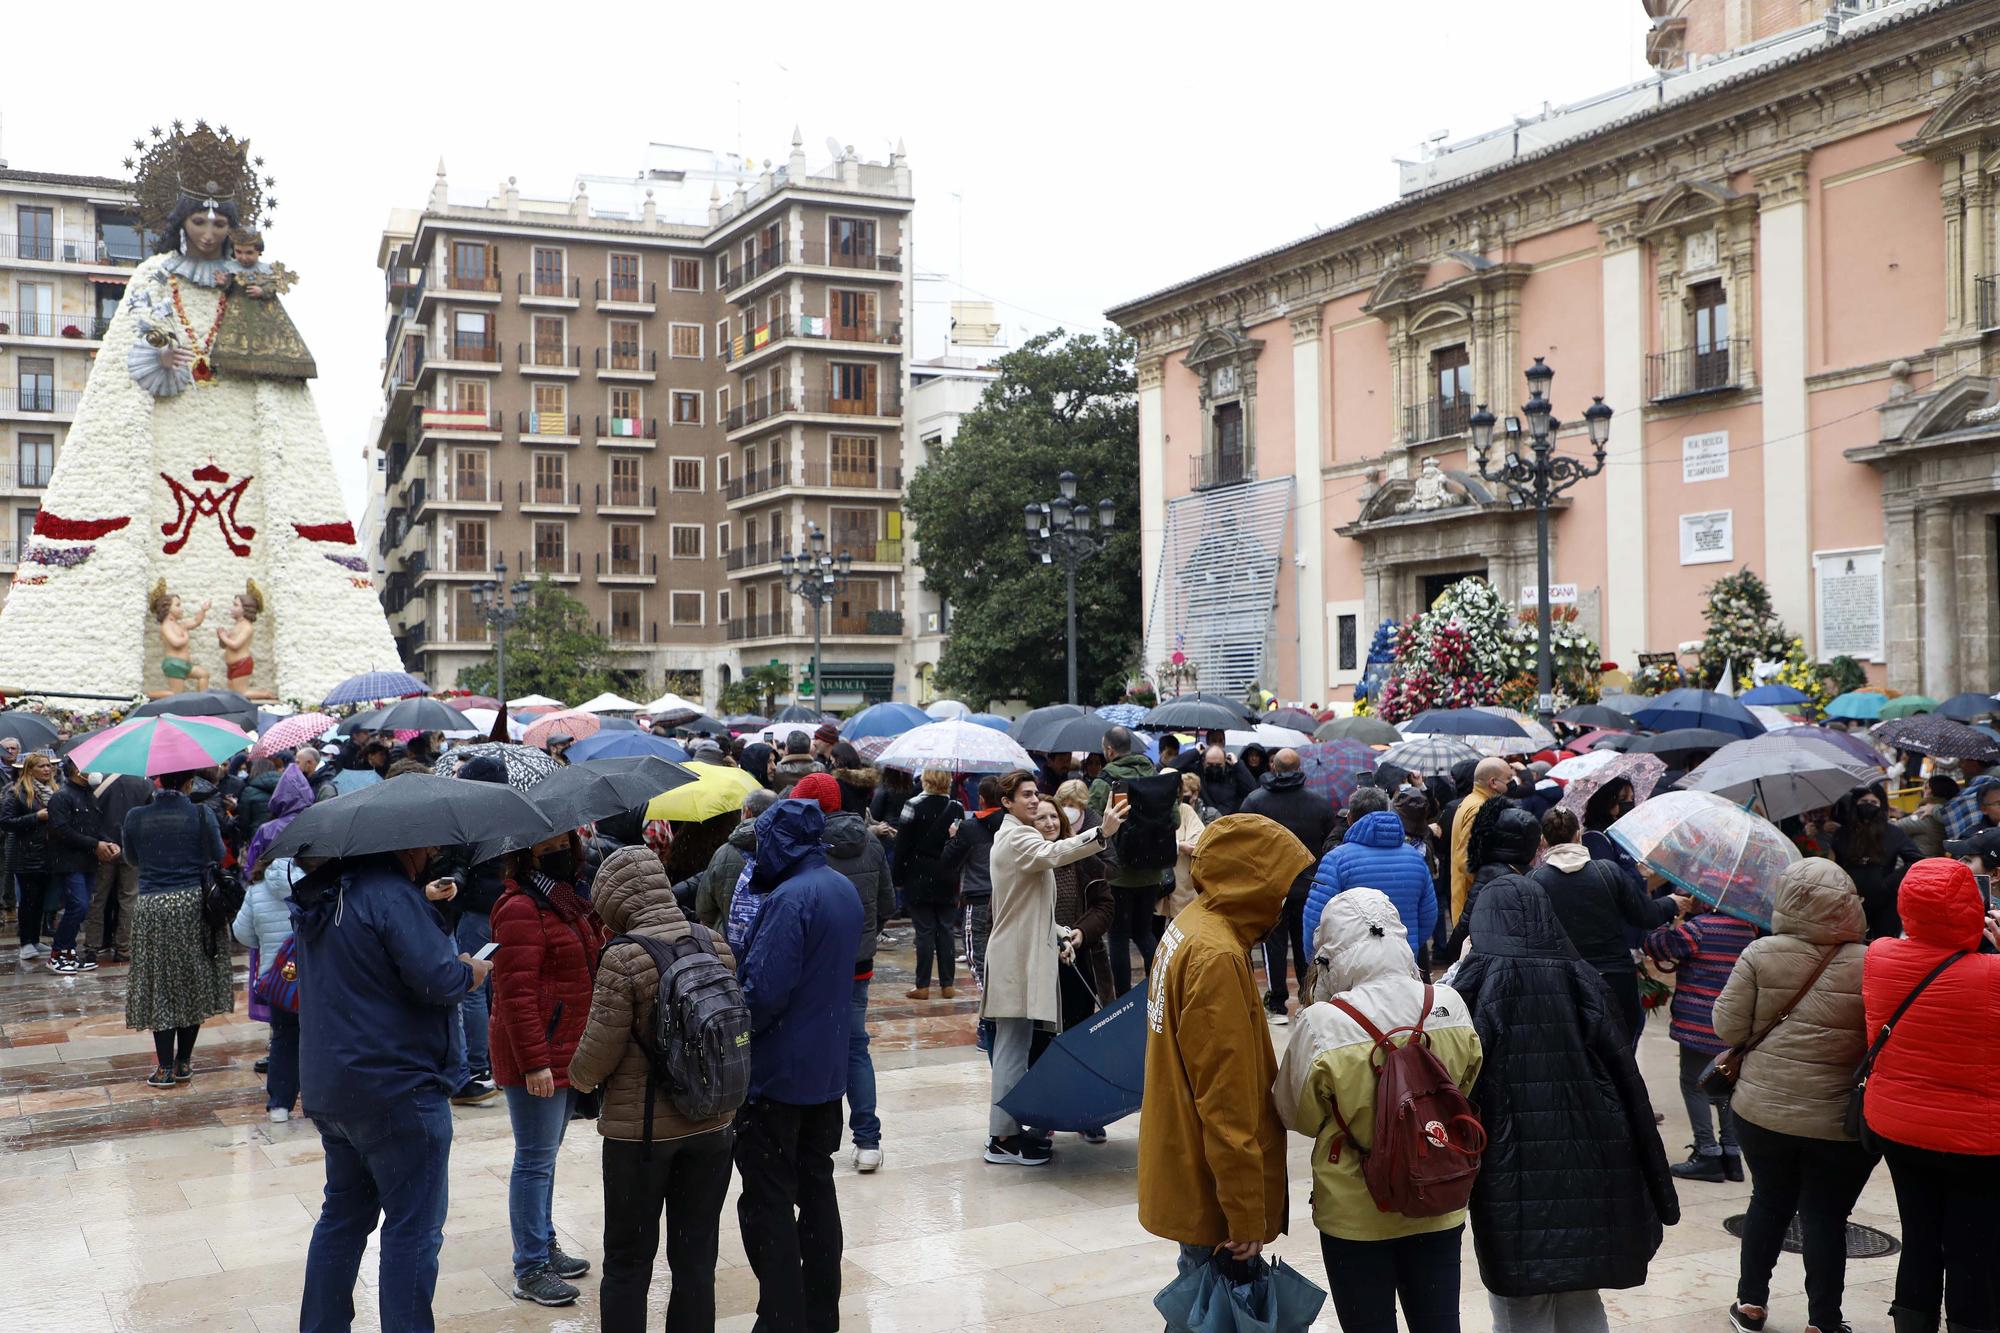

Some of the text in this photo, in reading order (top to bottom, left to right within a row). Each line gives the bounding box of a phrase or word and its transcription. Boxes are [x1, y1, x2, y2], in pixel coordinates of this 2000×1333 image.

[820, 679, 867, 690] ARMACIA
[1089, 1001, 1134, 1034] S14 MOTORBOX
